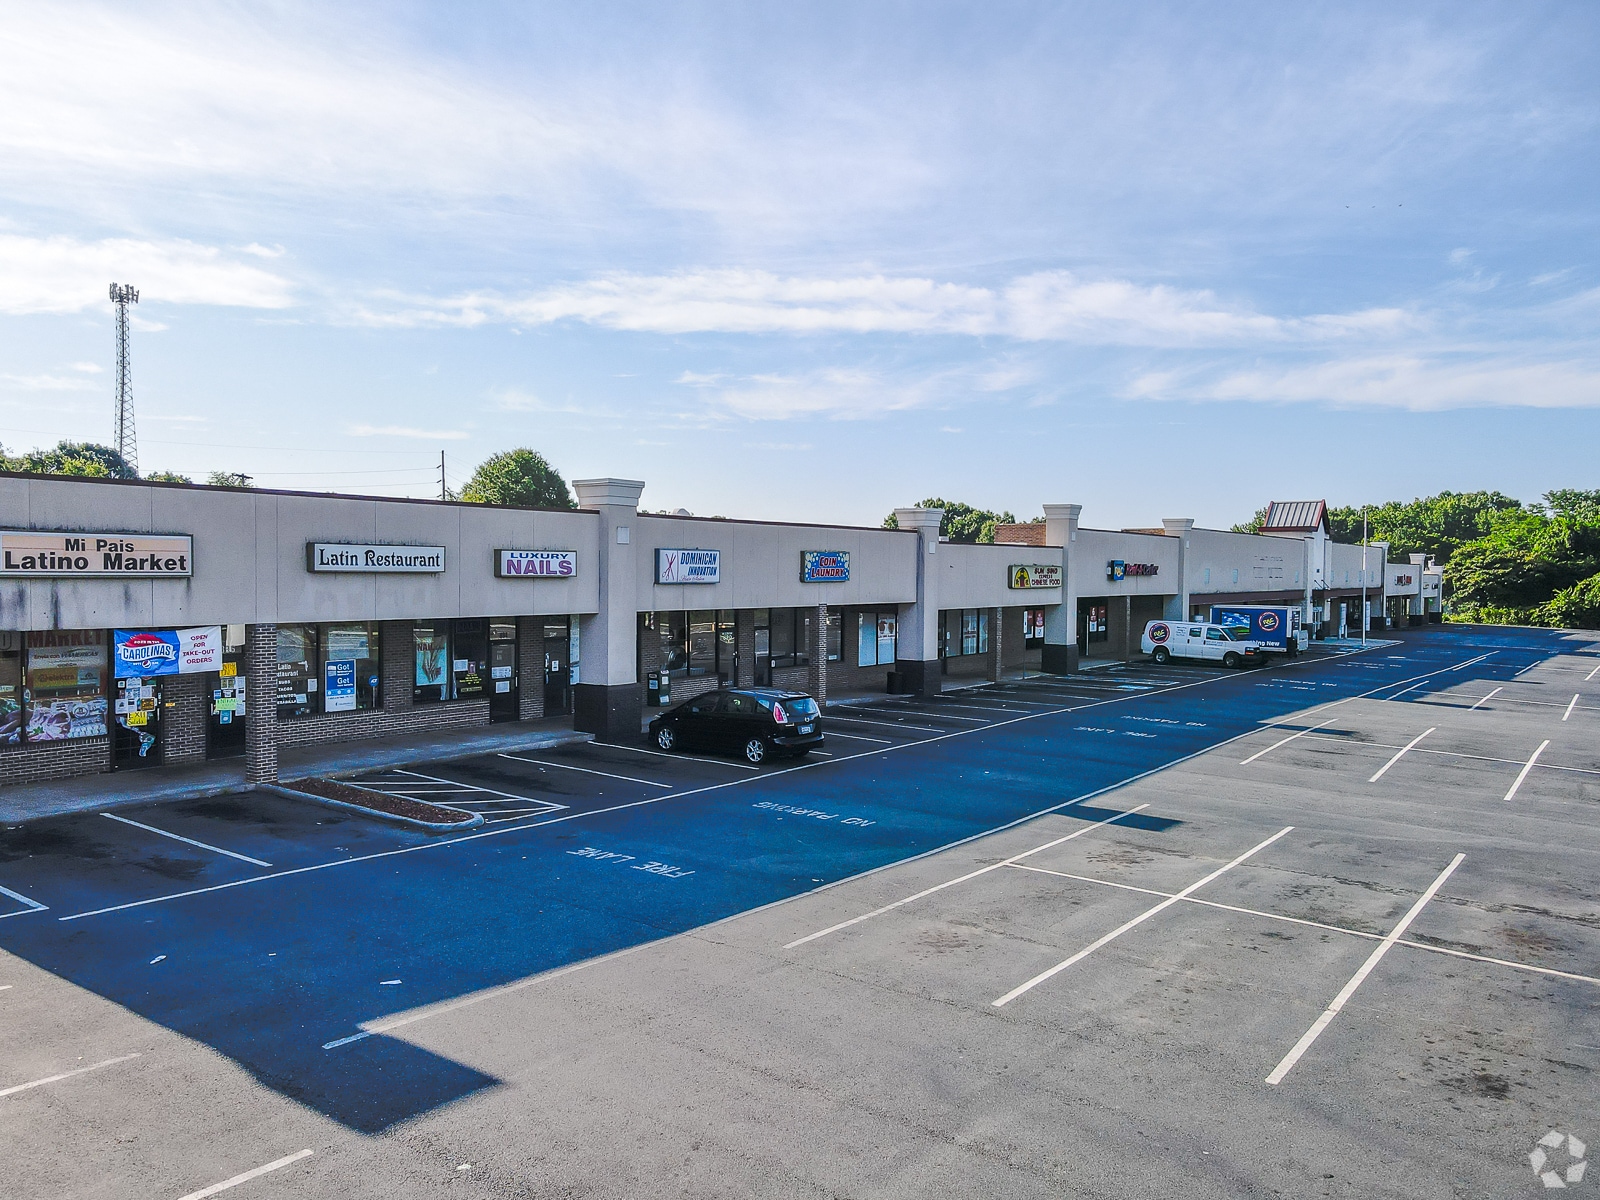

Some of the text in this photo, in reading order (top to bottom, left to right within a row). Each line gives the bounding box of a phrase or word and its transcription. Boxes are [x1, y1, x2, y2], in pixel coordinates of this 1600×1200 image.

[65, 538, 135, 552] Mi Pais
[5, 551, 187, 571] Latino Market
[318, 548, 441, 567] Latin Restaurant
[510, 552, 569, 560] LUXURY
[680, 552, 718, 565] DOMINICAN
[819, 556, 837, 567] COIN
[506, 559, 573, 575] NAILS
[811, 567, 845, 578] LAUNDRY
[123, 645, 171, 660] CAROLINAS
[183, 649, 216, 657] TAKE-OUT
[337, 663, 350, 671] Got
[337, 677, 350, 685] Get
